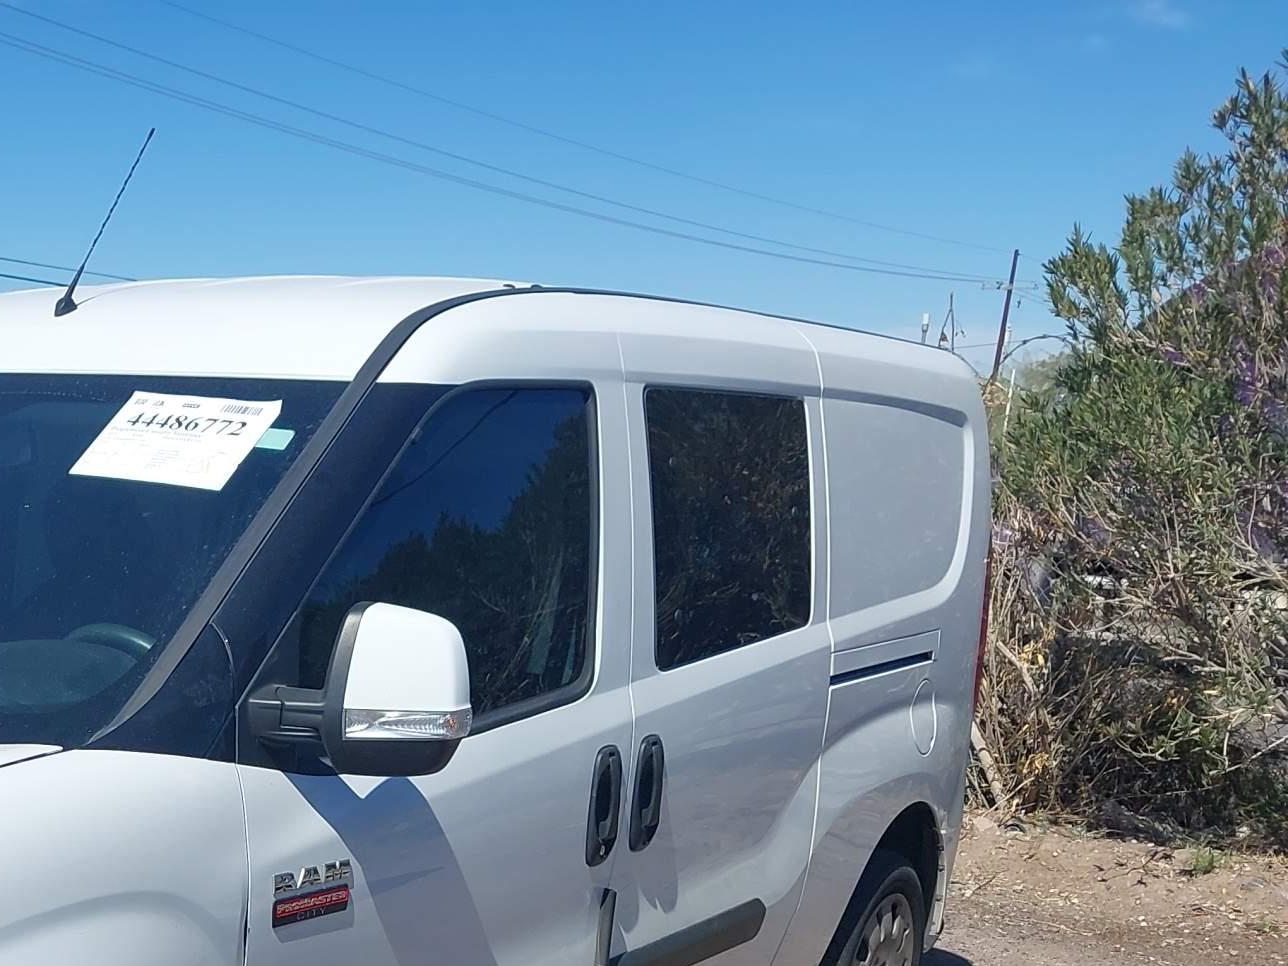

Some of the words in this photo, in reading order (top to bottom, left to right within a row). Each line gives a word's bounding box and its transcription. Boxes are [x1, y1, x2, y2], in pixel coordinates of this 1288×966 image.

[126, 411, 249, 437] 44486772
[272, 858, 353, 896] RAM
[296, 907, 328, 921] CITY
